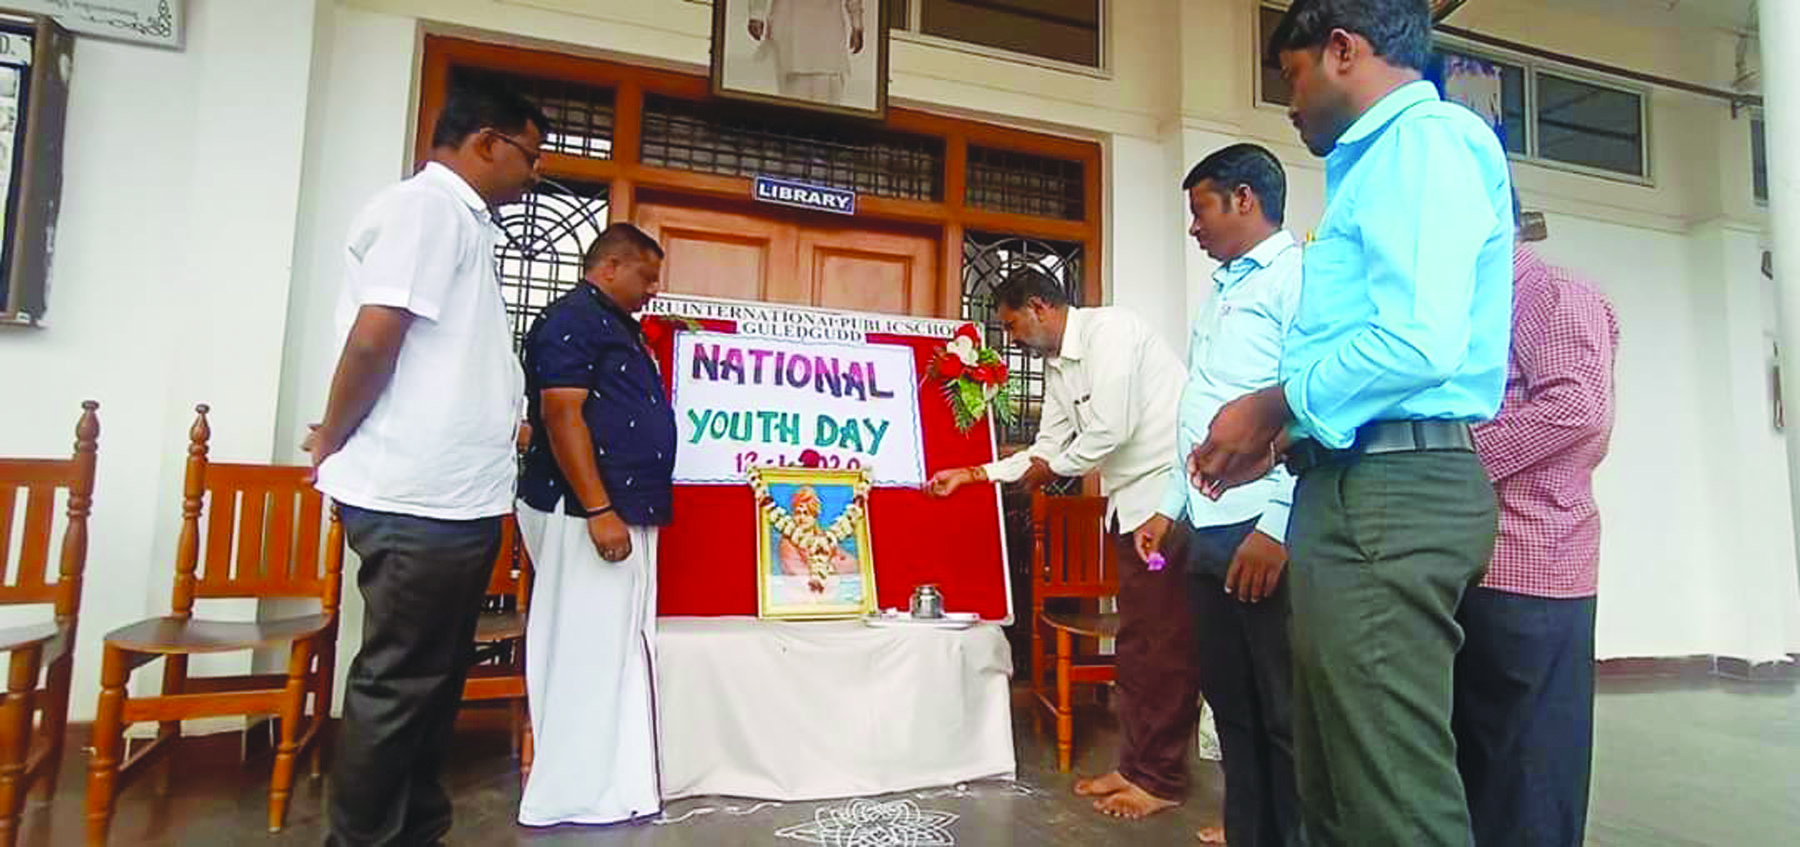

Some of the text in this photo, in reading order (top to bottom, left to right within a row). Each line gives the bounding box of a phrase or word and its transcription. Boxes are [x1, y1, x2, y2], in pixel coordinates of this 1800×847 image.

[759, 183, 850, 209] LIBRARY
[742, 320, 862, 342] GULEDGUDD
[692, 343, 894, 401] NATIONAL
[687, 408, 890, 456] YOUTH DAY
